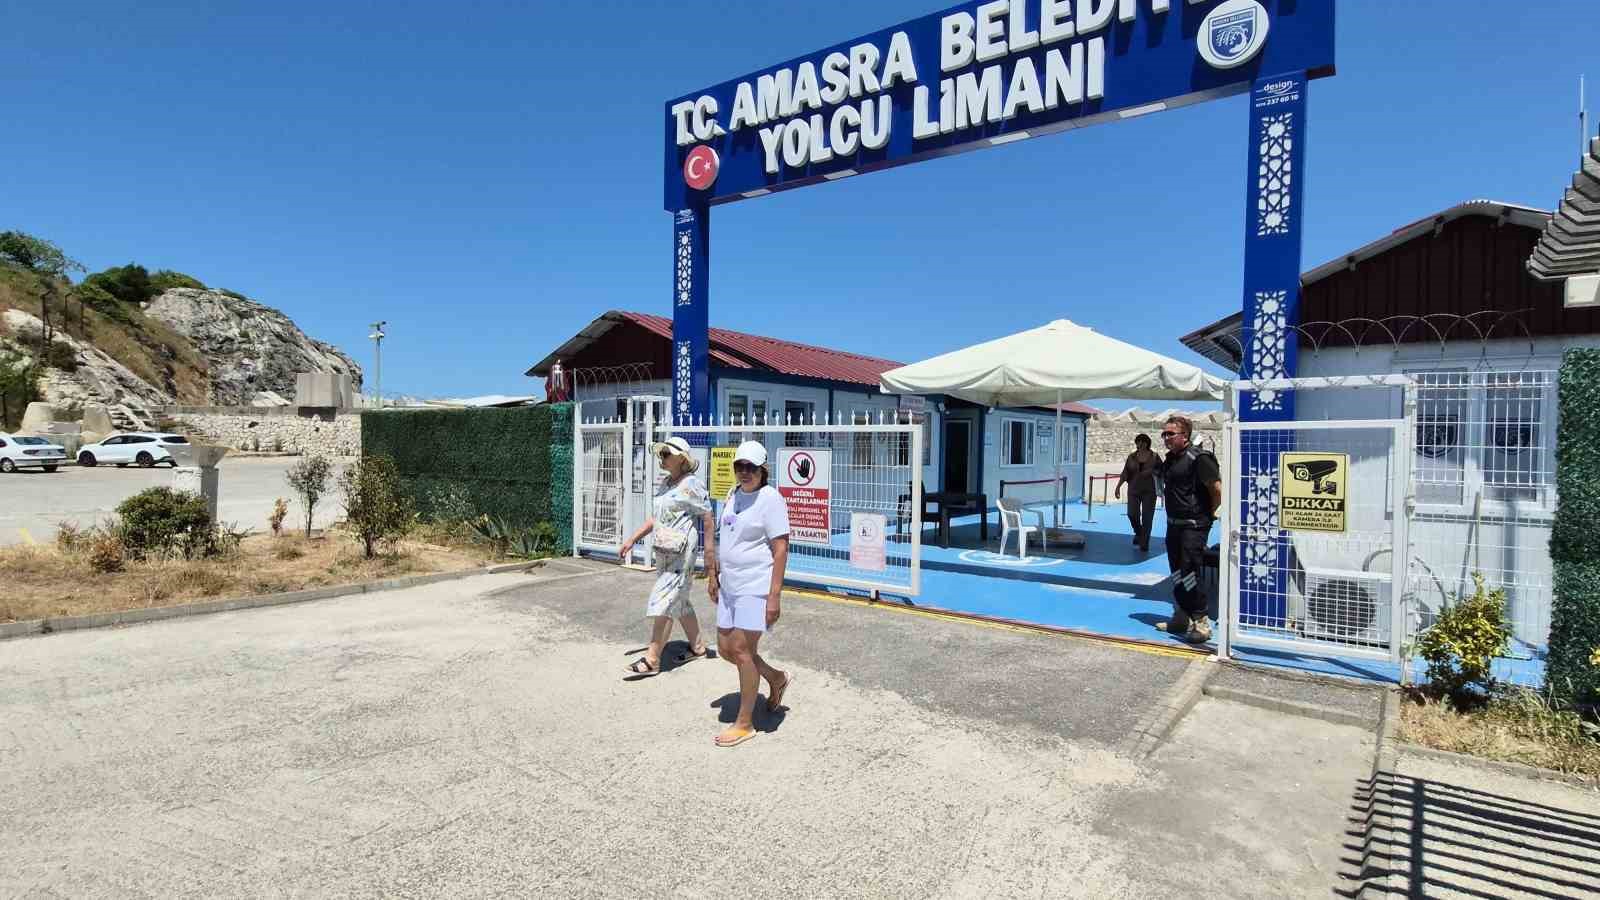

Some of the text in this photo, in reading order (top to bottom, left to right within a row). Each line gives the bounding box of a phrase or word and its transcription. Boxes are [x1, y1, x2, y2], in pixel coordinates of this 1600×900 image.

[729, 31, 918, 131] AMASRA
[1263, 80, 1294, 93] design
[759, 94, 893, 174] YOLCU
